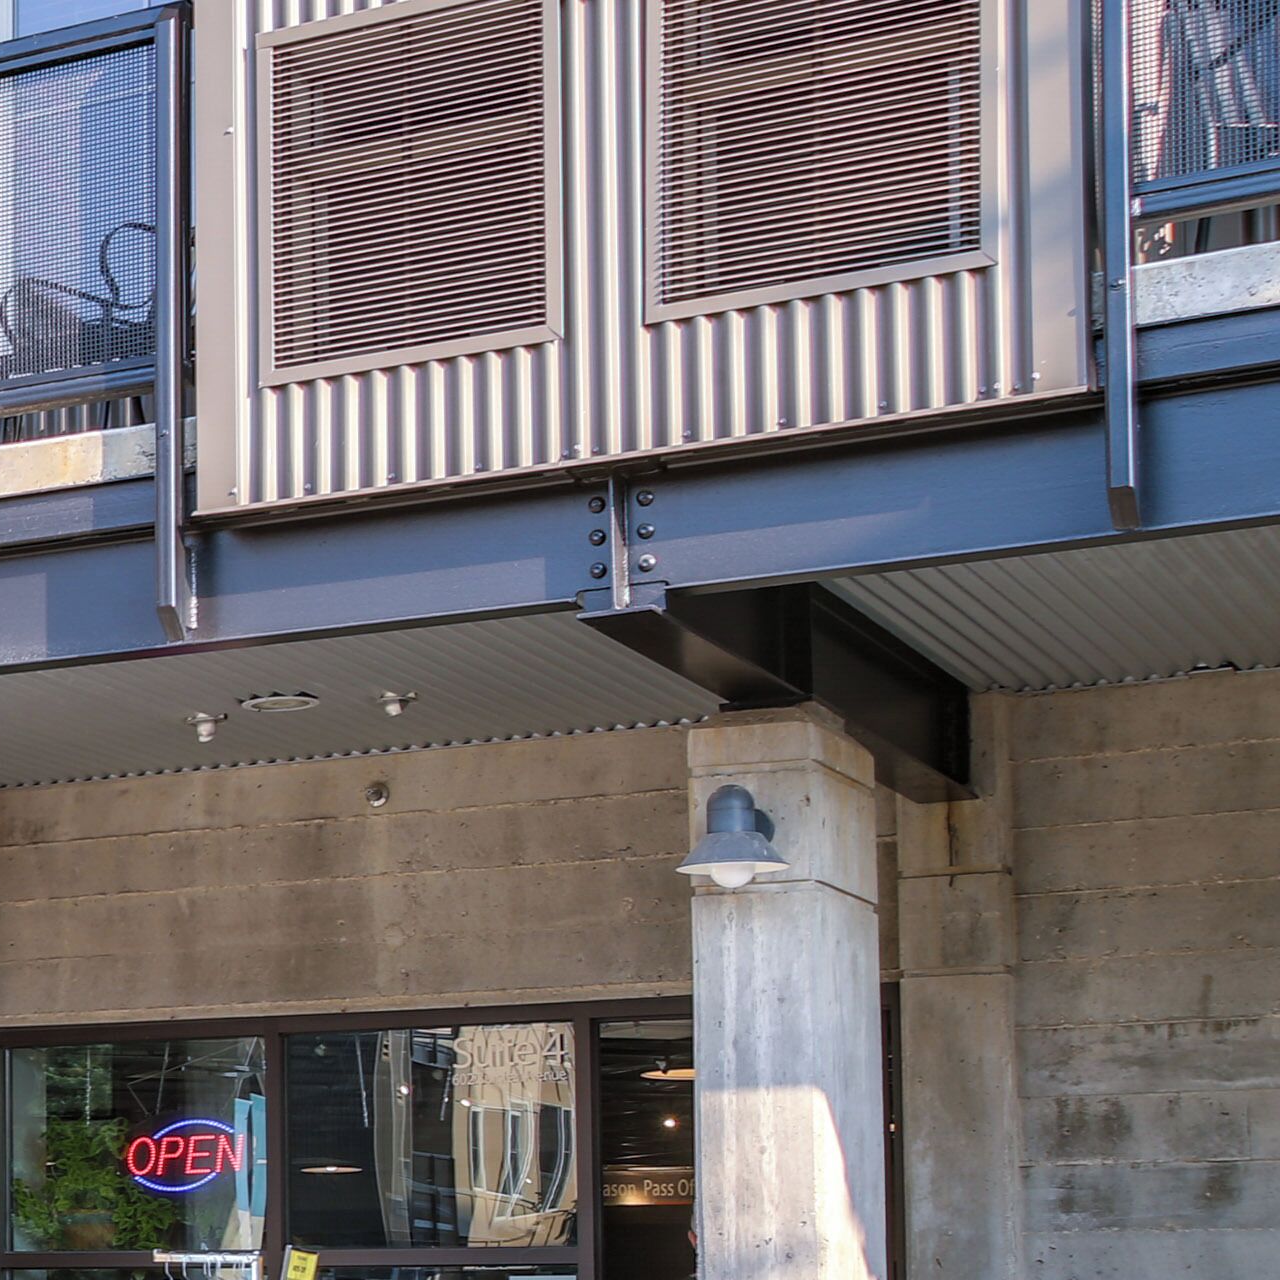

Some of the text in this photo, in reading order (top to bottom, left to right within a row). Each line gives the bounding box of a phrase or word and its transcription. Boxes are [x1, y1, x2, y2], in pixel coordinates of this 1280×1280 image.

[452, 1031, 569, 1069] Suite 4
[126, 1133, 245, 1176] OPEN
[602, 1178, 695, 1197] ason Pass Of
